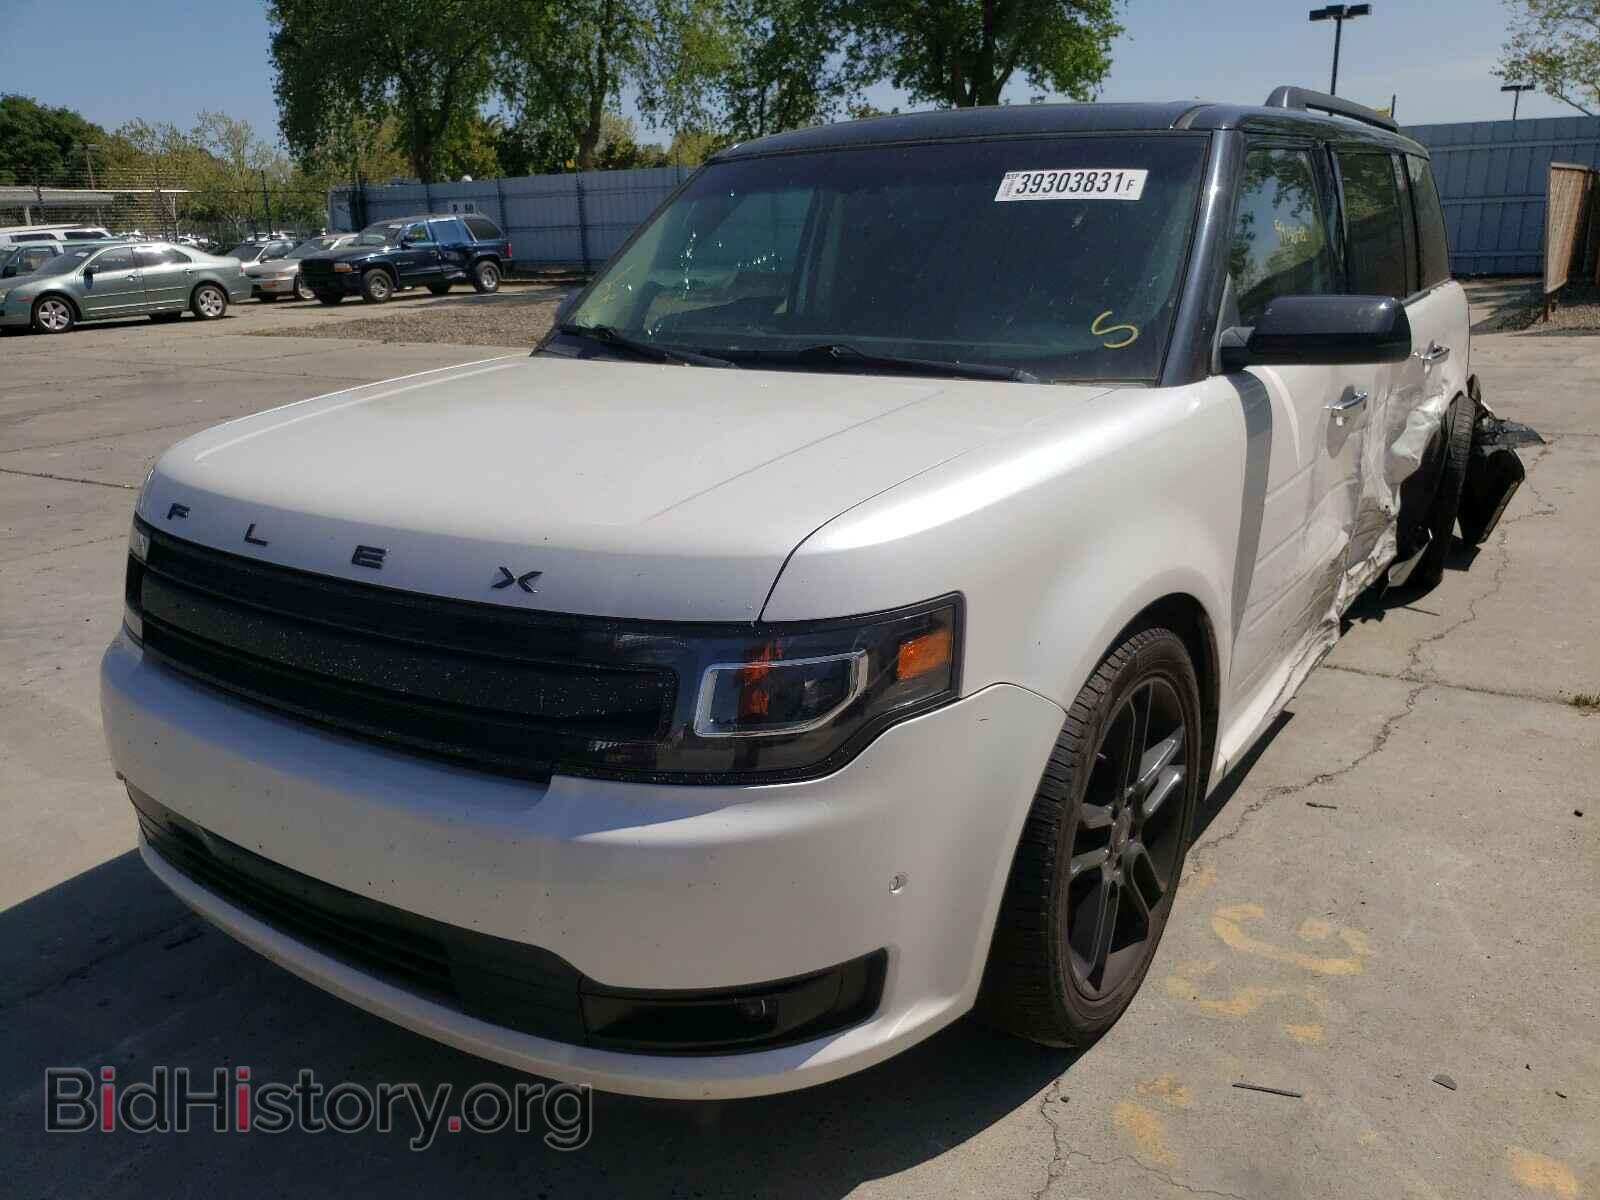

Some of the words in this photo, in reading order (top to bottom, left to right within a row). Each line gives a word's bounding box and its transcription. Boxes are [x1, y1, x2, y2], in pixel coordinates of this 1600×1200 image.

[1016, 172, 1124, 194] 39303831
[1126, 179, 1136, 191] F
[166, 502, 543, 594] FLEX
